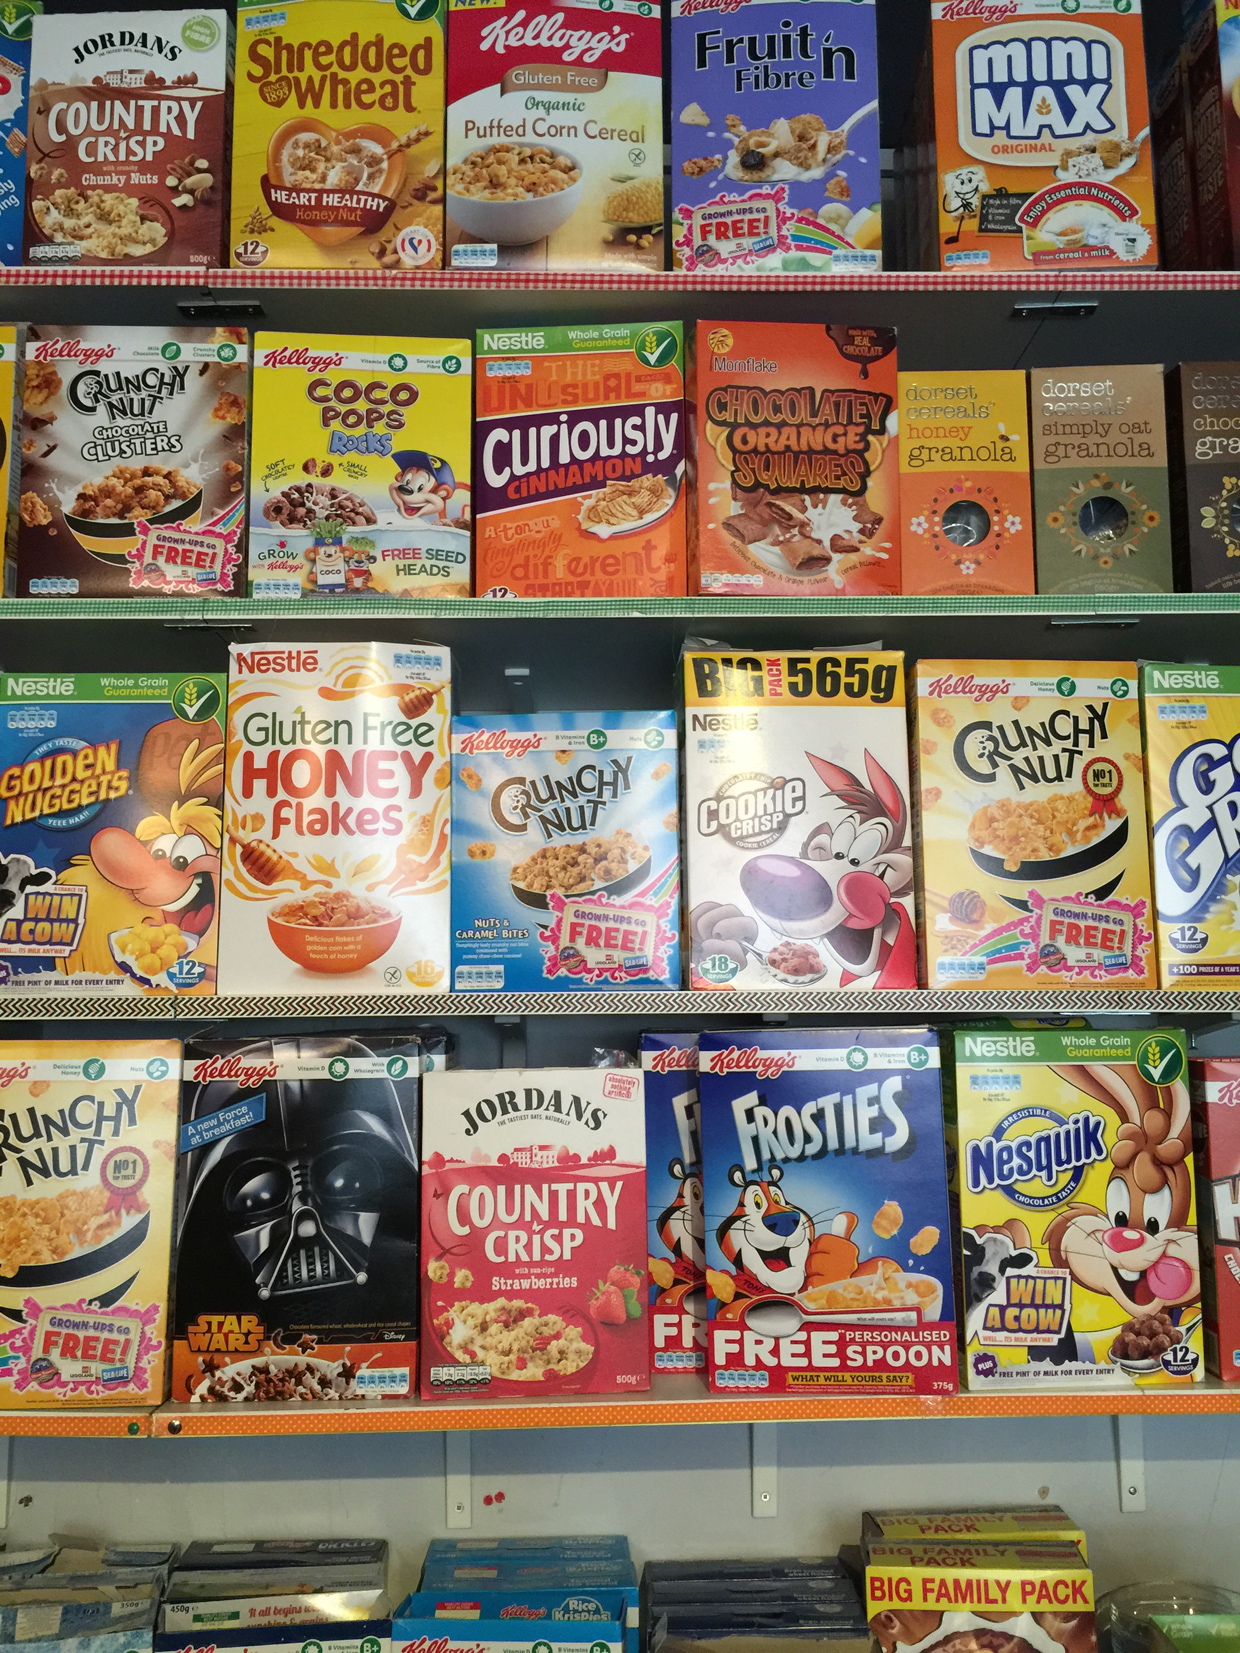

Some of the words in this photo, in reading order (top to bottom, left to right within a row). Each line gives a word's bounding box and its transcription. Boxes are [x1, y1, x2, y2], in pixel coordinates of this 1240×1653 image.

[72, 31, 182, 64] JORDANS
[479, 9, 634, 63] Kellogg's
[246, 32, 432, 84] Shredded
[969, 37, 1110, 85] mini
[263, 81, 288, 93] SINCE
[511, 70, 562, 85] Gluten
[566, 71, 598, 87] Free
[735, 64, 816, 93] Fibre
[266, 89, 290, 103] 1893
[524, 95, 586, 116] Organic
[48, 100, 203, 142] COUNTRY
[973, 83, 1115, 138] MAX
[464, 117, 526, 139] Puffed
[532, 117, 578, 138] Corn
[583, 119, 646, 144] Cereal
[991, 142, 1056, 155] ORIGINAL
[82, 173, 126, 187] Chunky
[130, 172, 158, 185] Nuts
[270, 188, 318, 206] HEART
[322, 193, 389, 212] HEALTHY
[296, 207, 336, 222] Honey
[338, 209, 362, 222] Nut
[700, 215, 770, 242] FREE!
[567, 329, 600, 340] Whole
[602, 328, 630, 339] Grain
[572, 338, 631, 348] Guaranteed
[854, 337, 870, 346] REAL
[34, 338, 116, 365] Kellogg's
[263, 346, 345, 372] Kellogg's
[842, 346, 883, 356] CHOCOLATE
[713, 356, 778, 373] Mornflake
[68, 364, 191, 414] CRUNCHY
[307, 377, 420, 408] COCO
[482, 372, 646, 414] UNUSUAL
[905, 383, 978, 402] dorset
[1041, 379, 1115, 398] dorset
[103, 392, 164, 422] NUT
[321, 405, 406, 430] POPS
[708, 386, 887, 430] CHOCOLATEY
[905, 400, 989, 420] cereals
[93, 420, 168, 440] CHOCOLATE
[732, 424, 866, 454] ORANGE
[906, 423, 973, 442] honey
[1042, 420, 1113, 439] simply
[1118, 420, 1152, 435] oat
[81, 434, 183, 462] CLUSTERS
[328, 429, 393, 457] ROCKS
[907, 441, 1016, 468] granola
[1043, 437, 1155, 464] granola
[265, 459, 286, 472] SOFT
[733, 452, 864, 492] SQUARES
[152, 543, 217, 570] FREE!
[258, 548, 299, 561] GROW
[381, 548, 422, 562] FREE
[425, 547, 467, 564] SEED
[510, 538, 662, 581] different
[396, 563, 450, 577] HEADS
[100, 677, 136, 687] Whole
[138, 677, 169, 687] Grain
[104, 687, 168, 697] Guaranteed
[691, 657, 765, 698] BIG
[765, 657, 783, 698] PACK
[787, 657, 898, 704] 565g
[928, 673, 1012, 703] Kellogg's
[243, 711, 353, 747] Gluten
[362, 711, 435, 748] Free
[34, 743, 54, 756] THEY
[54, 739, 77, 748] TASTE
[460, 729, 543, 758] Kellogg's
[953, 701, 1110, 783] CRUNCHY
[241, 748, 435, 800] HONEY
[1007, 747, 1083, 792] NUT
[491, 755, 634, 834] CRUNCHY
[537, 798, 607, 841] NUT
[26, 894, 80, 920] WIN
[3, 921, 18, 942] A
[20, 921, 75, 944] COW
[455, 929, 499, 940] CARAMEL
[501, 929, 529, 939] BITES
[474, 918, 502, 928] NUTS
[503, 918, 510, 928] &
[1177, 926, 1199, 943] 12
[568, 921, 649, 953] FREE!
[1048, 920, 1127, 952] FREE!
[175, 959, 198, 976] 12
[708, 955, 730, 973] 18
[11, 979, 27, 987] FREE
[44, 979, 52, 987] OF
[105, 978, 125, 986] ENTRY
[172, 977, 200, 985] SERVINGS
[1061, 1036, 1097, 1047] Whole
[1099, 1036, 1131, 1046] Grain
[1066, 1046, 1131, 1058] Guaranteed
[192, 1054, 281, 1088] Kellogg's
[709, 1046, 798, 1077] Kellogg's
[187, 1125, 197, 1136] A
[197, 1118, 218, 1132] new
[218, 1104, 249, 1124] Force
[460, 1087, 608, 1137] JORDANS
[731, 1075, 911, 1173] FROSTIES
[16, 1137, 106, 1188] NUT
[966, 1111, 1107, 1191] Nesquik
[447, 1180, 624, 1237] COUNTRY
[491, 1275, 579, 1292] Strawberries
[743, 1279, 766, 1294] TONY
[1009, 1276, 1064, 1305] WIN
[49, 1316, 115, 1333] GROWN-UPS
[116, 1325, 130, 1335] GO
[187, 1314, 266, 1334] STAR
[986, 1306, 1001, 1330] A
[1004, 1307, 1063, 1332] COW
[41, 1330, 132, 1365] FREE!
[187, 1332, 265, 1352] WARS
[382, 1331, 406, 1342] Disney
[713, 1329, 842, 1368] FREE
[845, 1330, 950, 1342] PERSONALISED
[845, 1345, 952, 1368] SPOON
[1170, 1346, 1190, 1364] 12
[977, 1360, 994, 1371] PLUS
[998, 1370, 1014, 1378] FREE
[1042, 1369, 1060, 1377] MILK
[1073, 1368, 1095, 1376] EVERY
[1095, 1367, 1116, 1375] ENTRY
[615, 1374, 638, 1386] 500g
[791, 1374, 821, 1384] WHAT
[823, 1374, 847, 1383] WILL
[849, 1374, 884, 1384] YOURS
[885, 1373, 910, 1384] SAY?
[932, 1381, 954, 1391] 375g
[919, 1523, 982, 1535] PACK
[872, 1547, 916, 1557] BIG
[921, 1547, 1009, 1558] FAMILY
[909, 1555, 976, 1567] PACK
[869, 1576, 913, 1603] BIG
[921, 1577, 1012, 1605] FAMILY
[1021, 1579, 1090, 1605] PACK
[170, 1604, 190, 1615] 450g
[500, 1605, 548, 1620] Kellogg's
[568, 1599, 597, 1611] Rice
